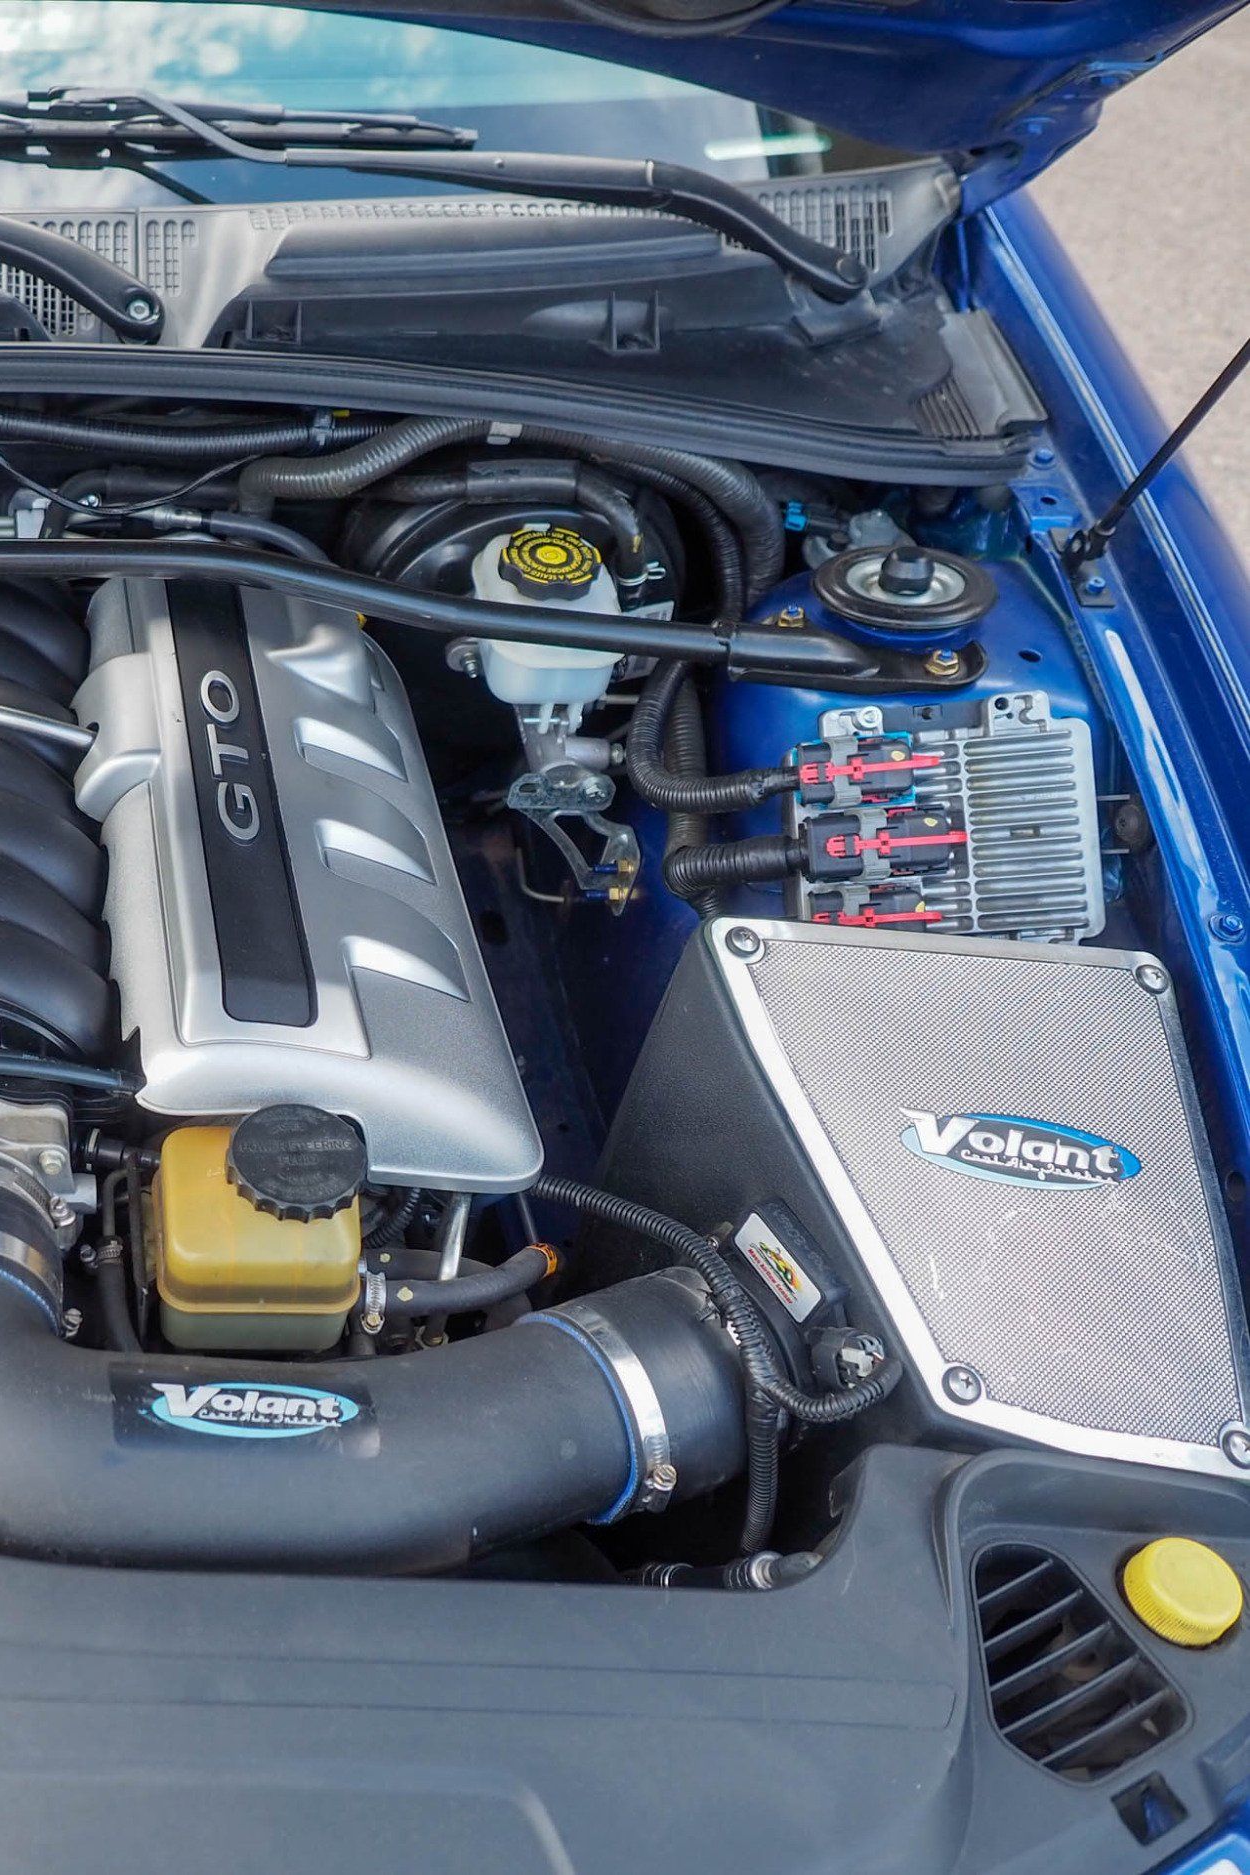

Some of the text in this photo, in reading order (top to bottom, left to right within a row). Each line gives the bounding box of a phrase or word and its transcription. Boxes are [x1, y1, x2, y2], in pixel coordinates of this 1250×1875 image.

[200, 669, 261, 844] GTO
[899, 1107, 1119, 1174] Volant
[151, 1383, 341, 1418] Volant
